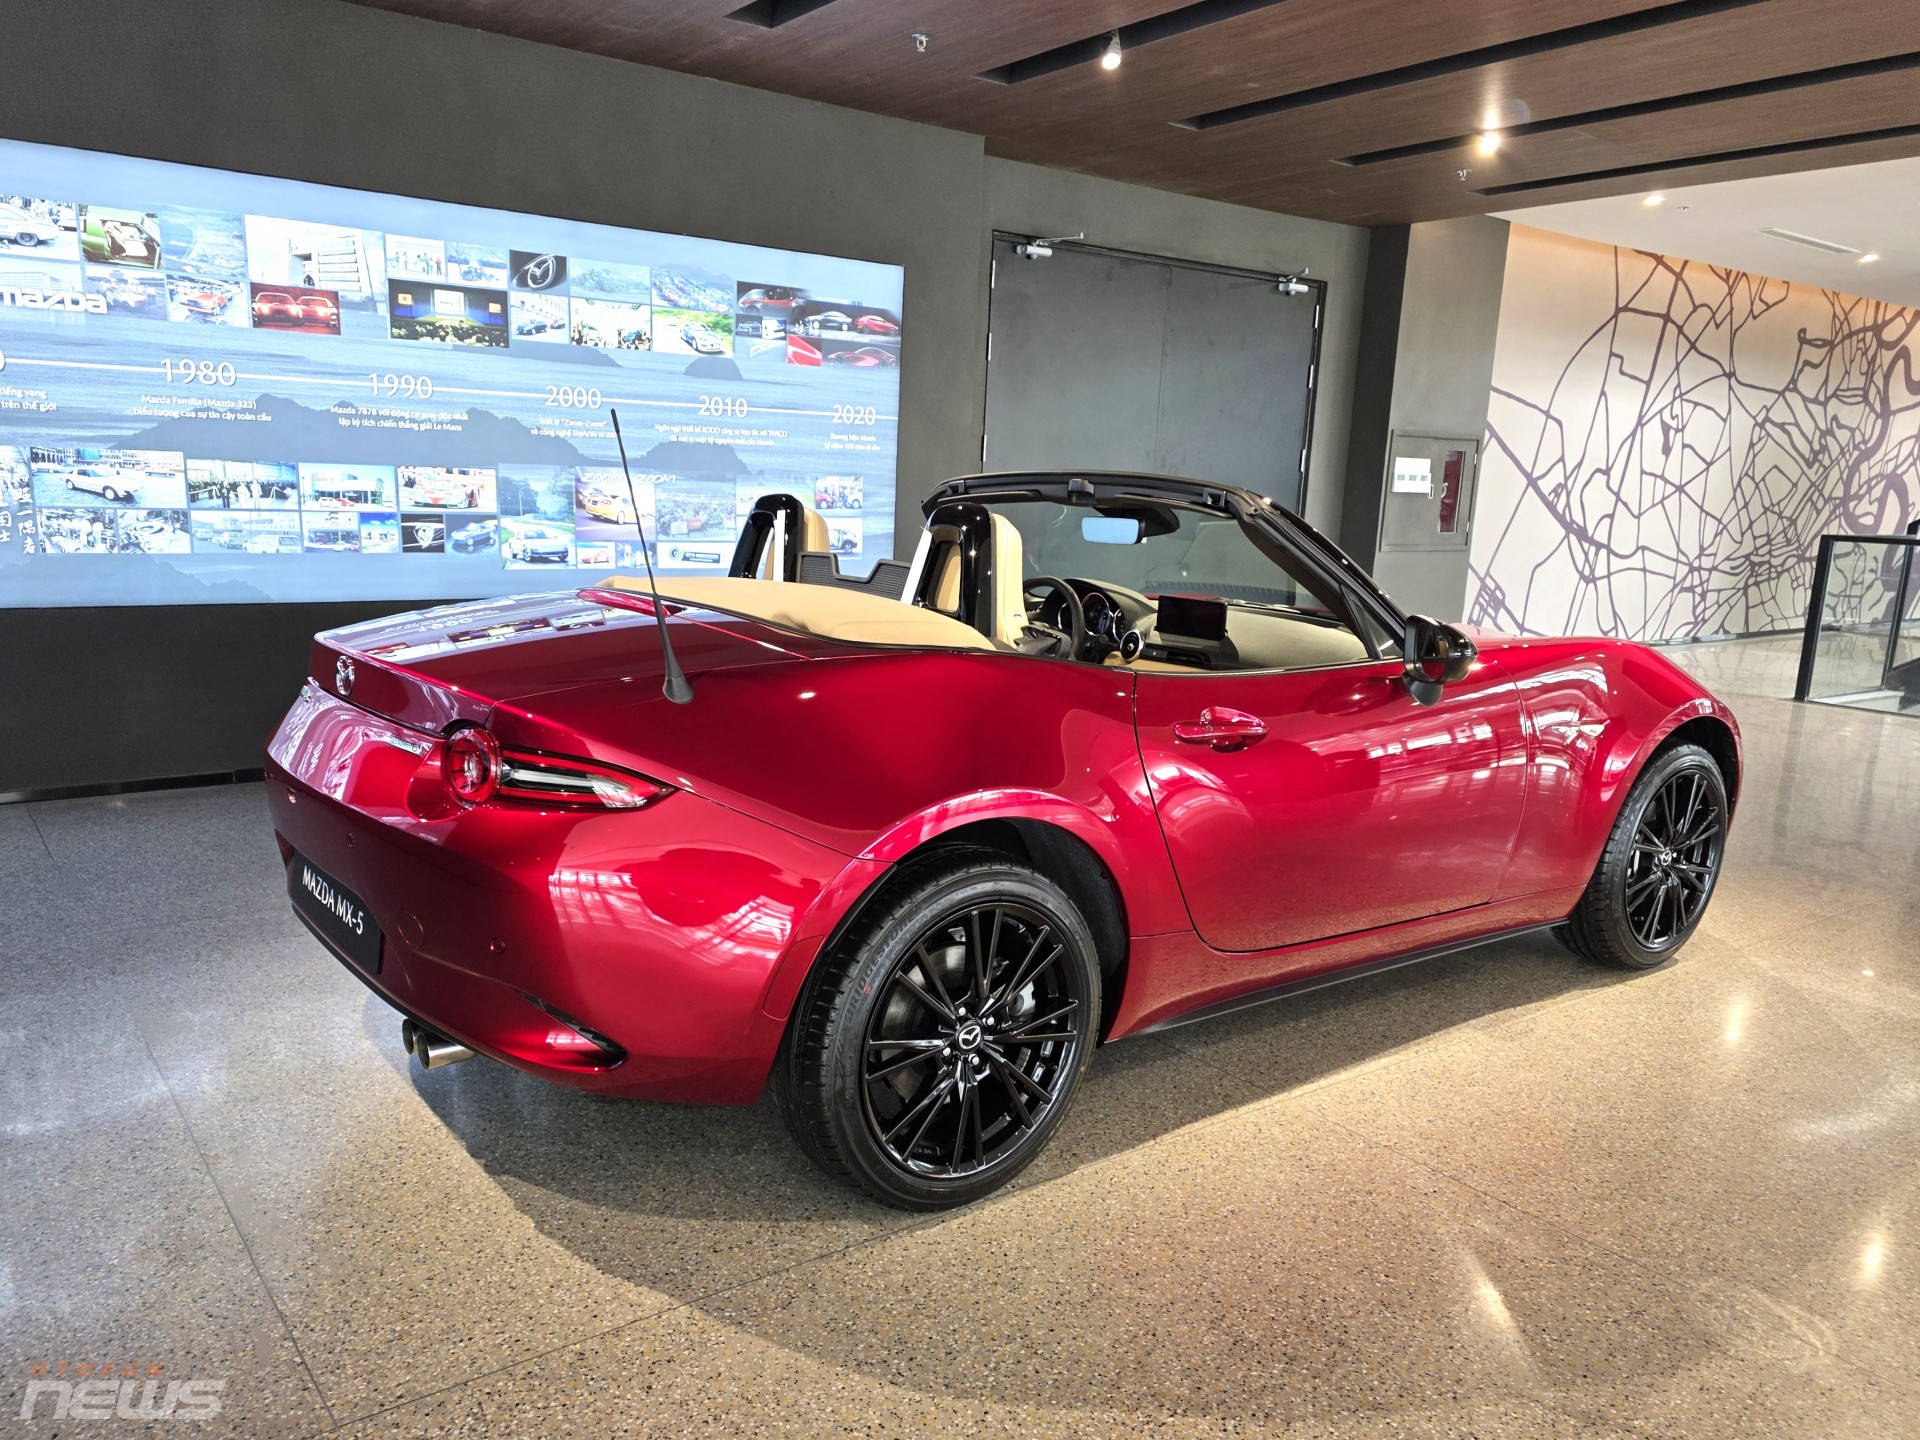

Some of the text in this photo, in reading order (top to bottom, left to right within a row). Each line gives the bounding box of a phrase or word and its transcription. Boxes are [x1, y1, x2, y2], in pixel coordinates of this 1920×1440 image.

[160, 358, 236, 386] 1980
[24, 390, 47, 400] vang
[368, 372, 433, 399] 1990
[1, 400, 20, 408] trên
[22, 400, 38, 409] thế
[141, 395, 256, 409] Mazda Familia (Mazda 323)
[544, 385, 602, 409] 2000
[698, 395, 748, 417] 2010
[330, 405, 356, 414] Mazda
[832, 404, 876, 425] 2020
[302, 865, 364, 935] MAZDA MX-5
